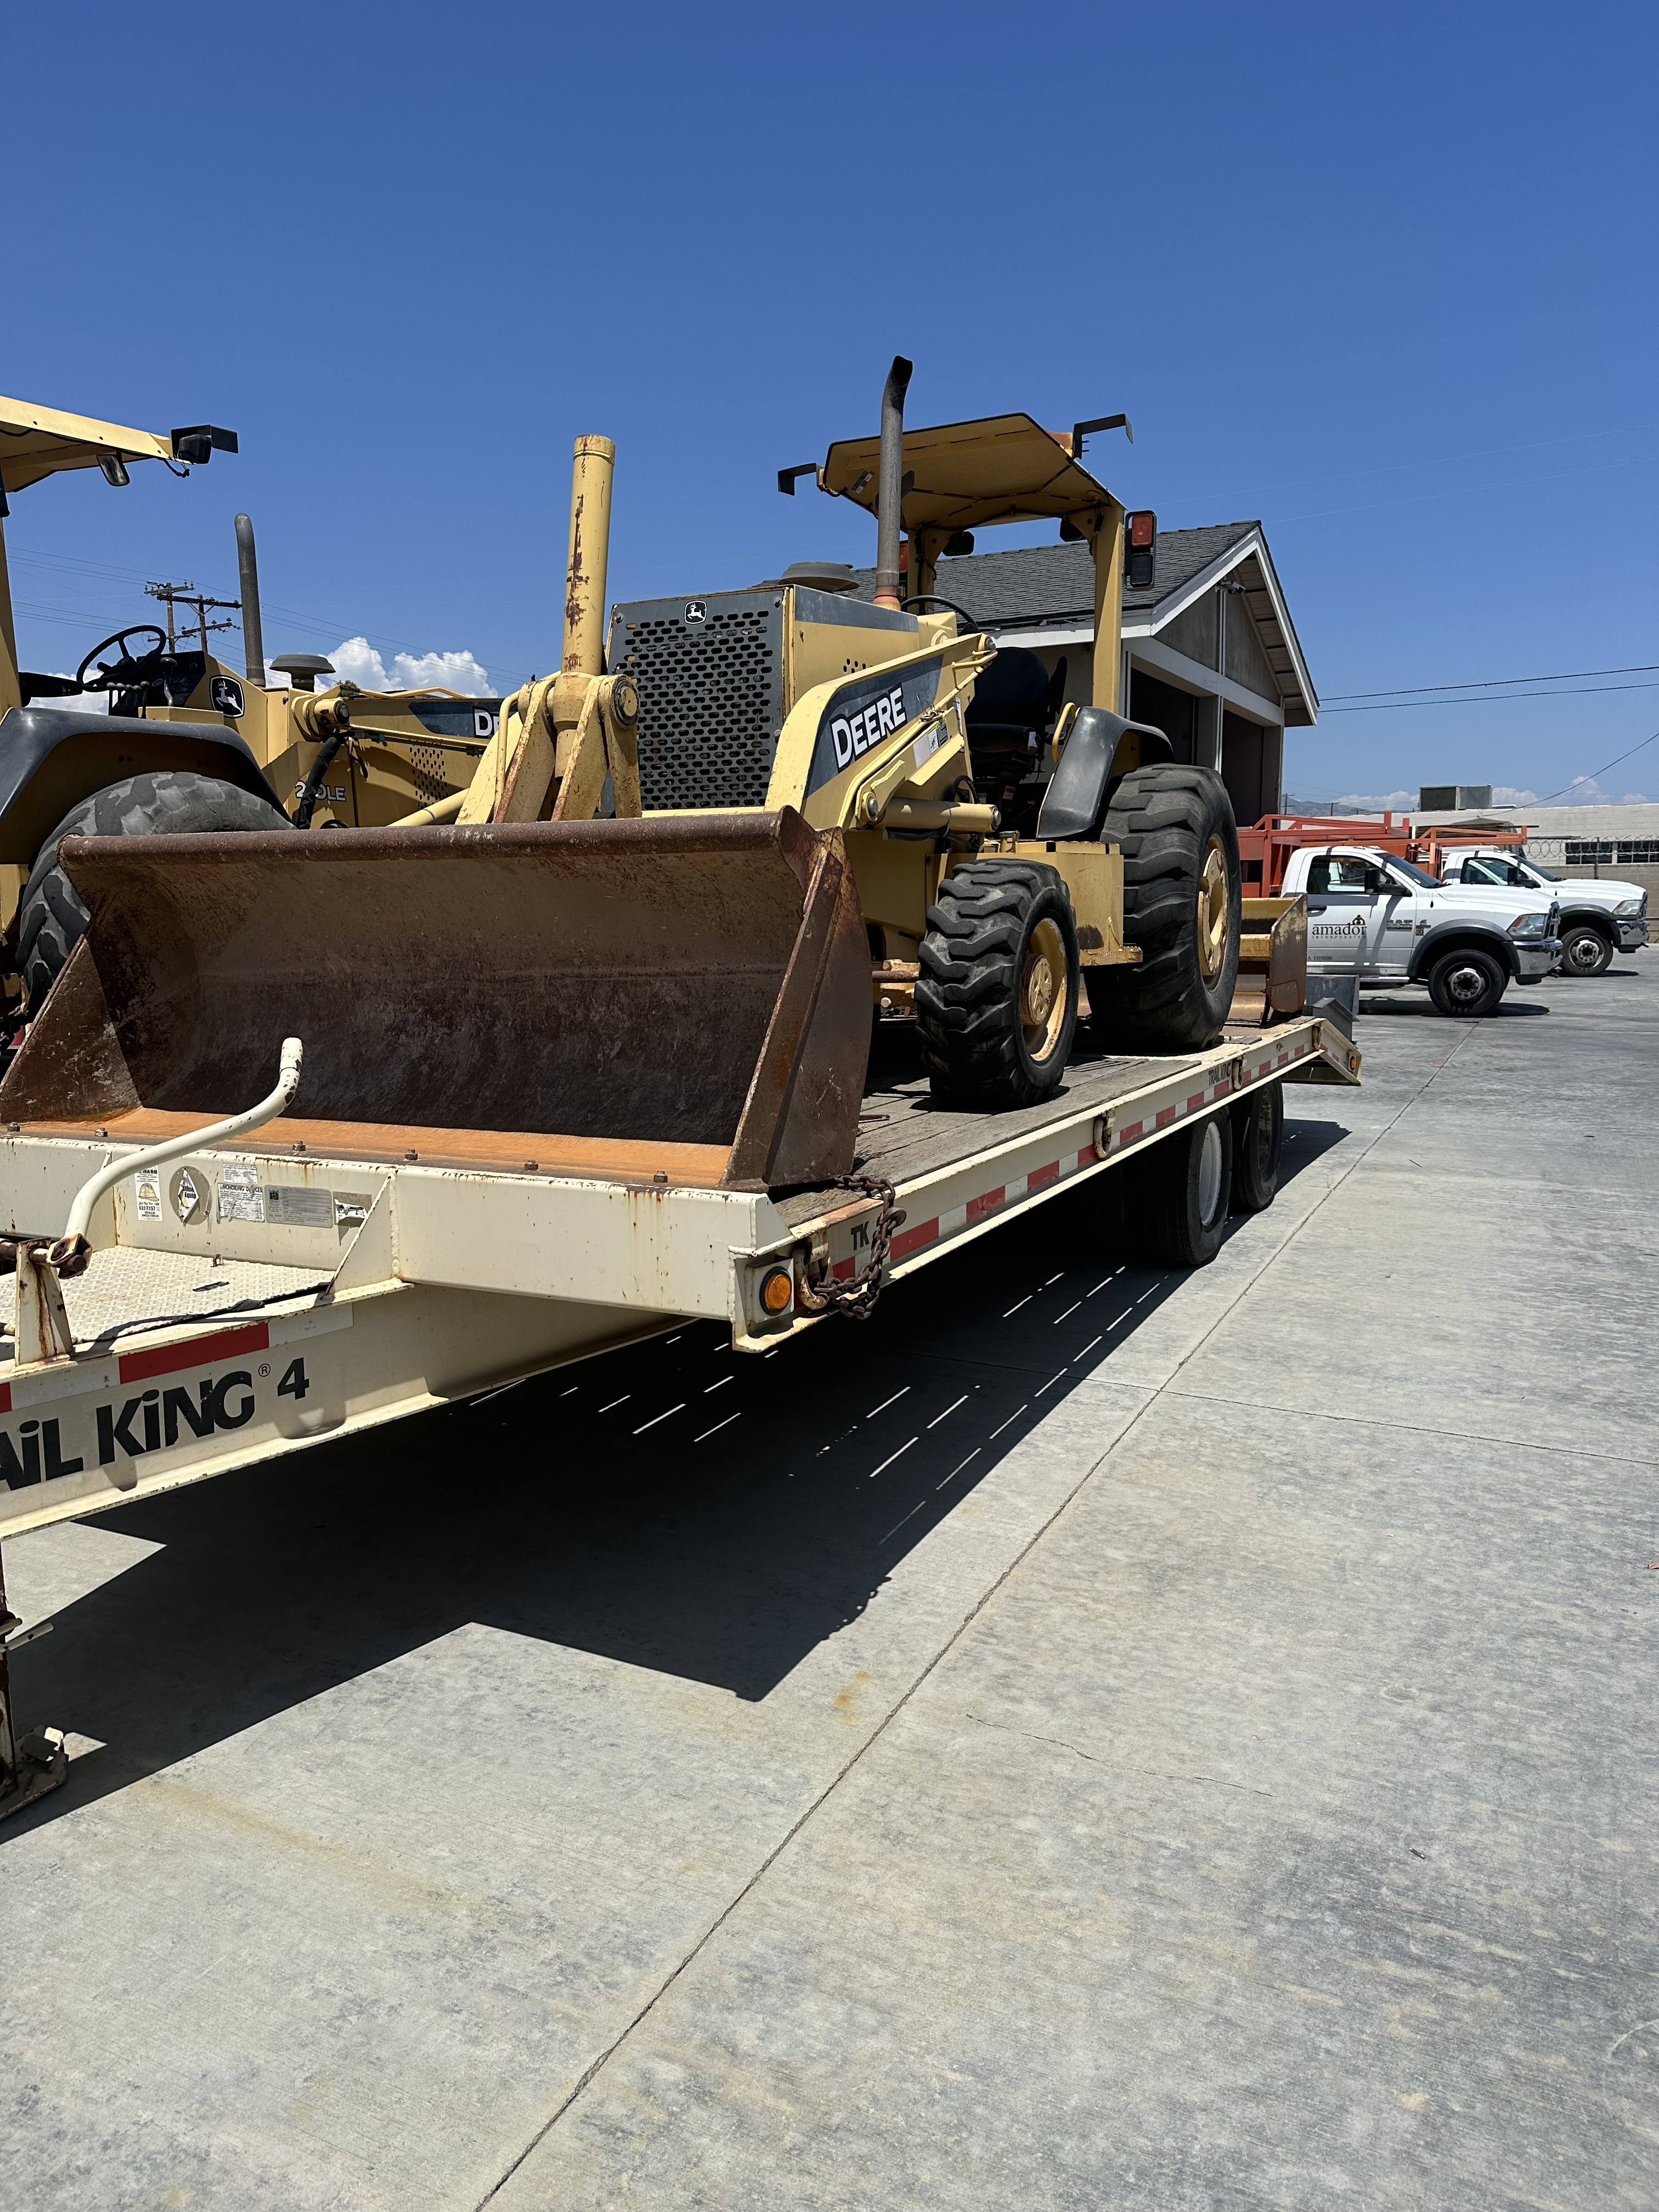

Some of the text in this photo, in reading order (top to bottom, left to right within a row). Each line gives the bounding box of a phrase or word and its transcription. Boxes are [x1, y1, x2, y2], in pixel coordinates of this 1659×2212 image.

[830, 685, 907, 770] DEERE
[295, 780, 347, 802] 20LE
[1312, 923, 1367, 935] amador
[850, 1221, 870, 1251] TK
[277, 1357, 310, 1400] 4
